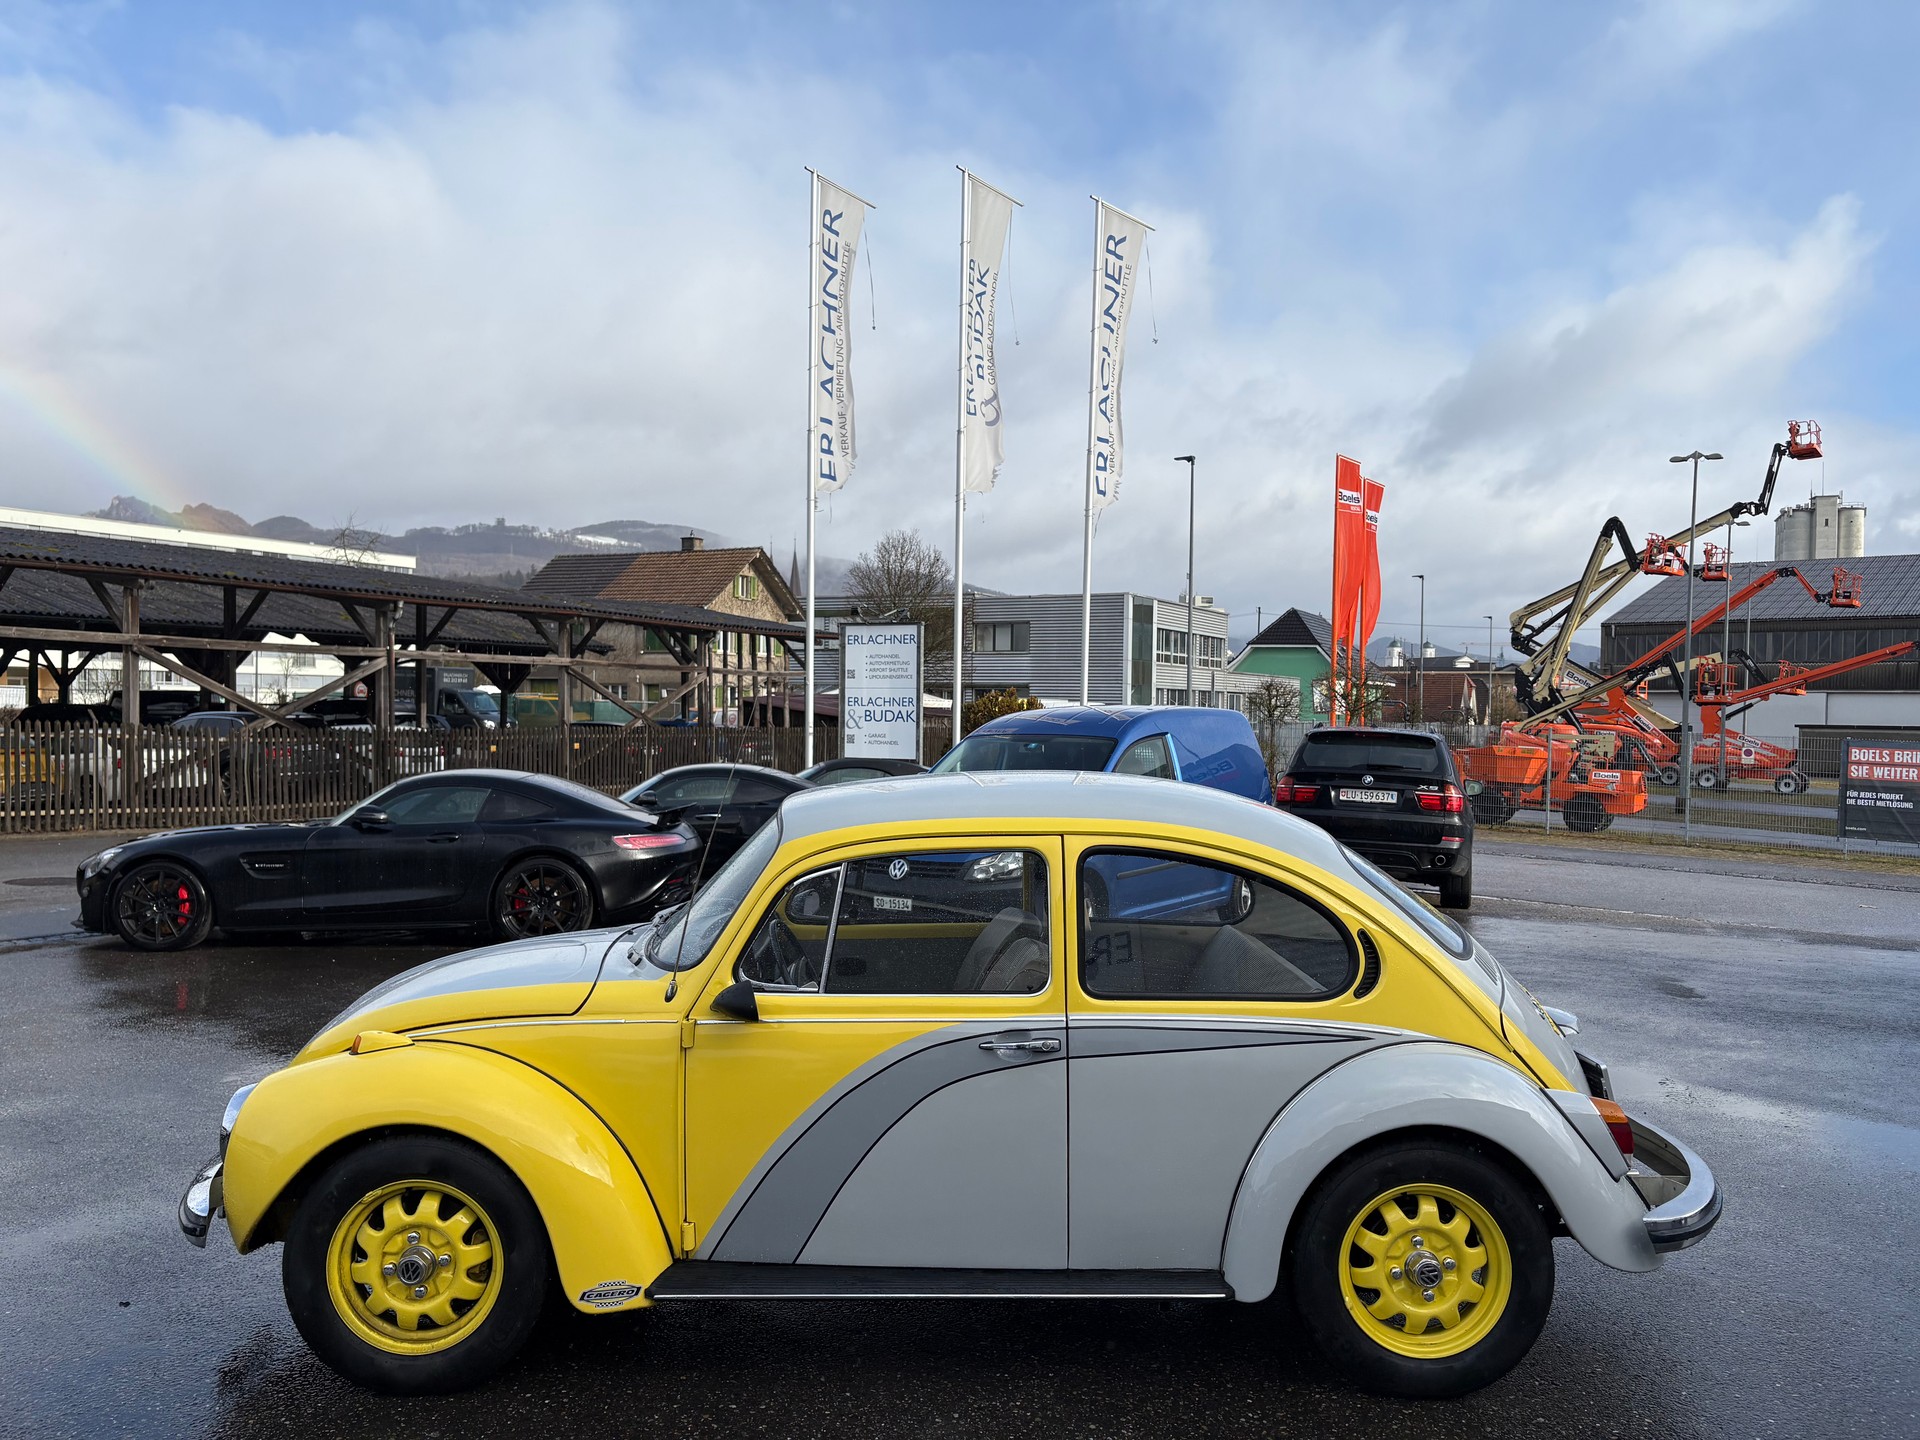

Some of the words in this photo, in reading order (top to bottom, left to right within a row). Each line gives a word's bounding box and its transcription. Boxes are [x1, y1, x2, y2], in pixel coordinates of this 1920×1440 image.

[836, 338, 844, 404] VERMIETUNG
[987, 344, 996, 385] GARAGE
[838, 411, 850, 458] VERKAUF
[847, 634, 917, 645] ERLACHNER
[1566, 671, 1591, 688] Boels
[847, 697, 915, 707] ERLACHNER
[846, 709, 863, 729] &
[864, 710, 916, 723] BUDAK
[1851, 749, 1890, 762] BOELS
[1851, 765, 1869, 777] SIE
[1873, 766, 1918, 780] WEITER
[1846, 789, 1858, 797] FÜR
